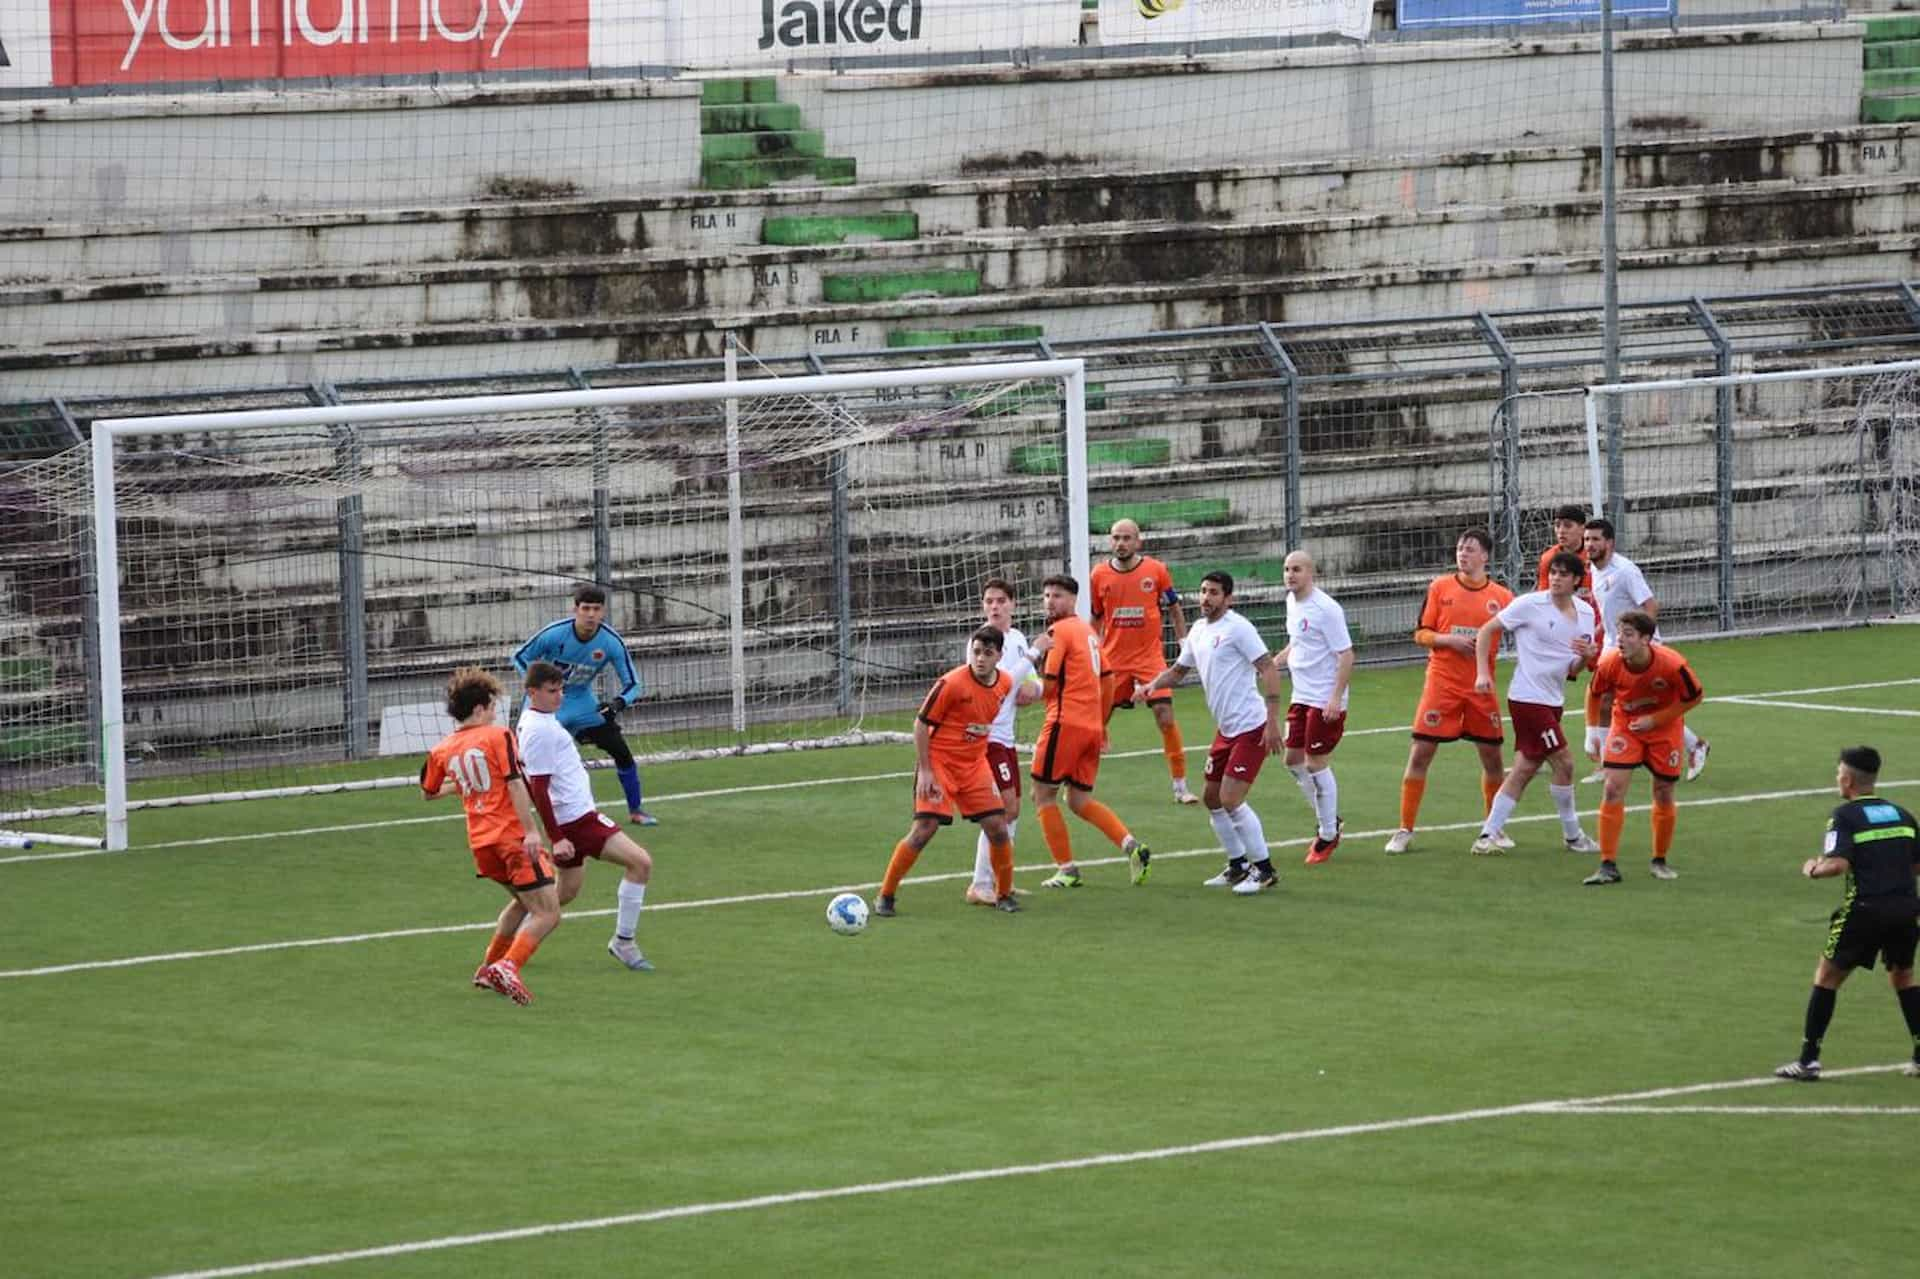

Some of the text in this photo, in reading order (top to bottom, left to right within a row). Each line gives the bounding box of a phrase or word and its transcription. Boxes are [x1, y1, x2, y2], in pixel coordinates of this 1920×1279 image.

[1863, 144, 1886, 160] FILA
[690, 213, 736, 230] FILA H
[753, 271, 780, 287] FILA
[815, 327, 860, 345] FILA F
[940, 445, 965, 459] FILA
[1000, 504, 1026, 519] FILA
[1035, 500, 1046, 515] C
[1541, 728, 1559, 749] 11
[1668, 750, 1681, 768] 3
[448, 747, 492, 798] 10
[997, 761, 1011, 782] 5
